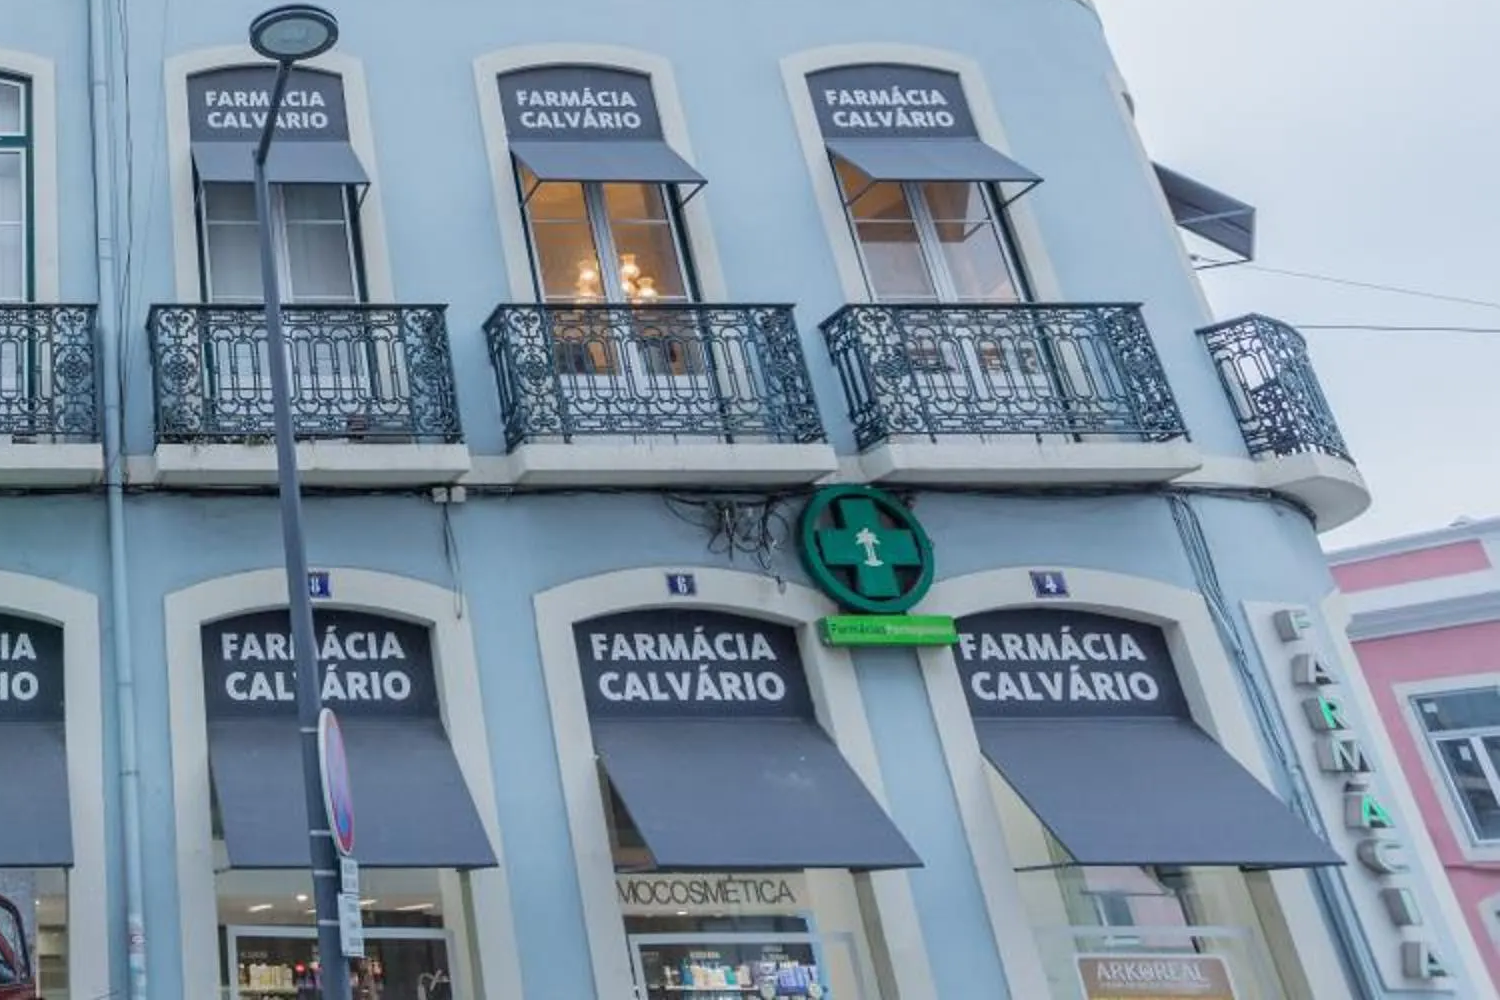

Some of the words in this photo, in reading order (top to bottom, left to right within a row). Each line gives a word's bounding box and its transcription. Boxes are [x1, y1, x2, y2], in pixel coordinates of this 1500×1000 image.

[516, 87, 638, 107] FARMÁCIA
[824, 85, 948, 106] FARMÁCIA
[521, 107, 642, 128] CALVÁRIO
[832, 107, 955, 127] CALVÁRIO
[677, 575, 687, 594] 6
[1045, 575, 1057, 593] 4
[590, 625, 777, 661] FARMÁCIA
[958, 625, 1147, 661] FARMÁCIA
[225, 663, 411, 701] CALÁRIO
[599, 664, 786, 701] CALVÁRIO
[971, 664, 1159, 701] CALVÁRIO
[1274, 608, 1454, 979] FARMÁCIA
